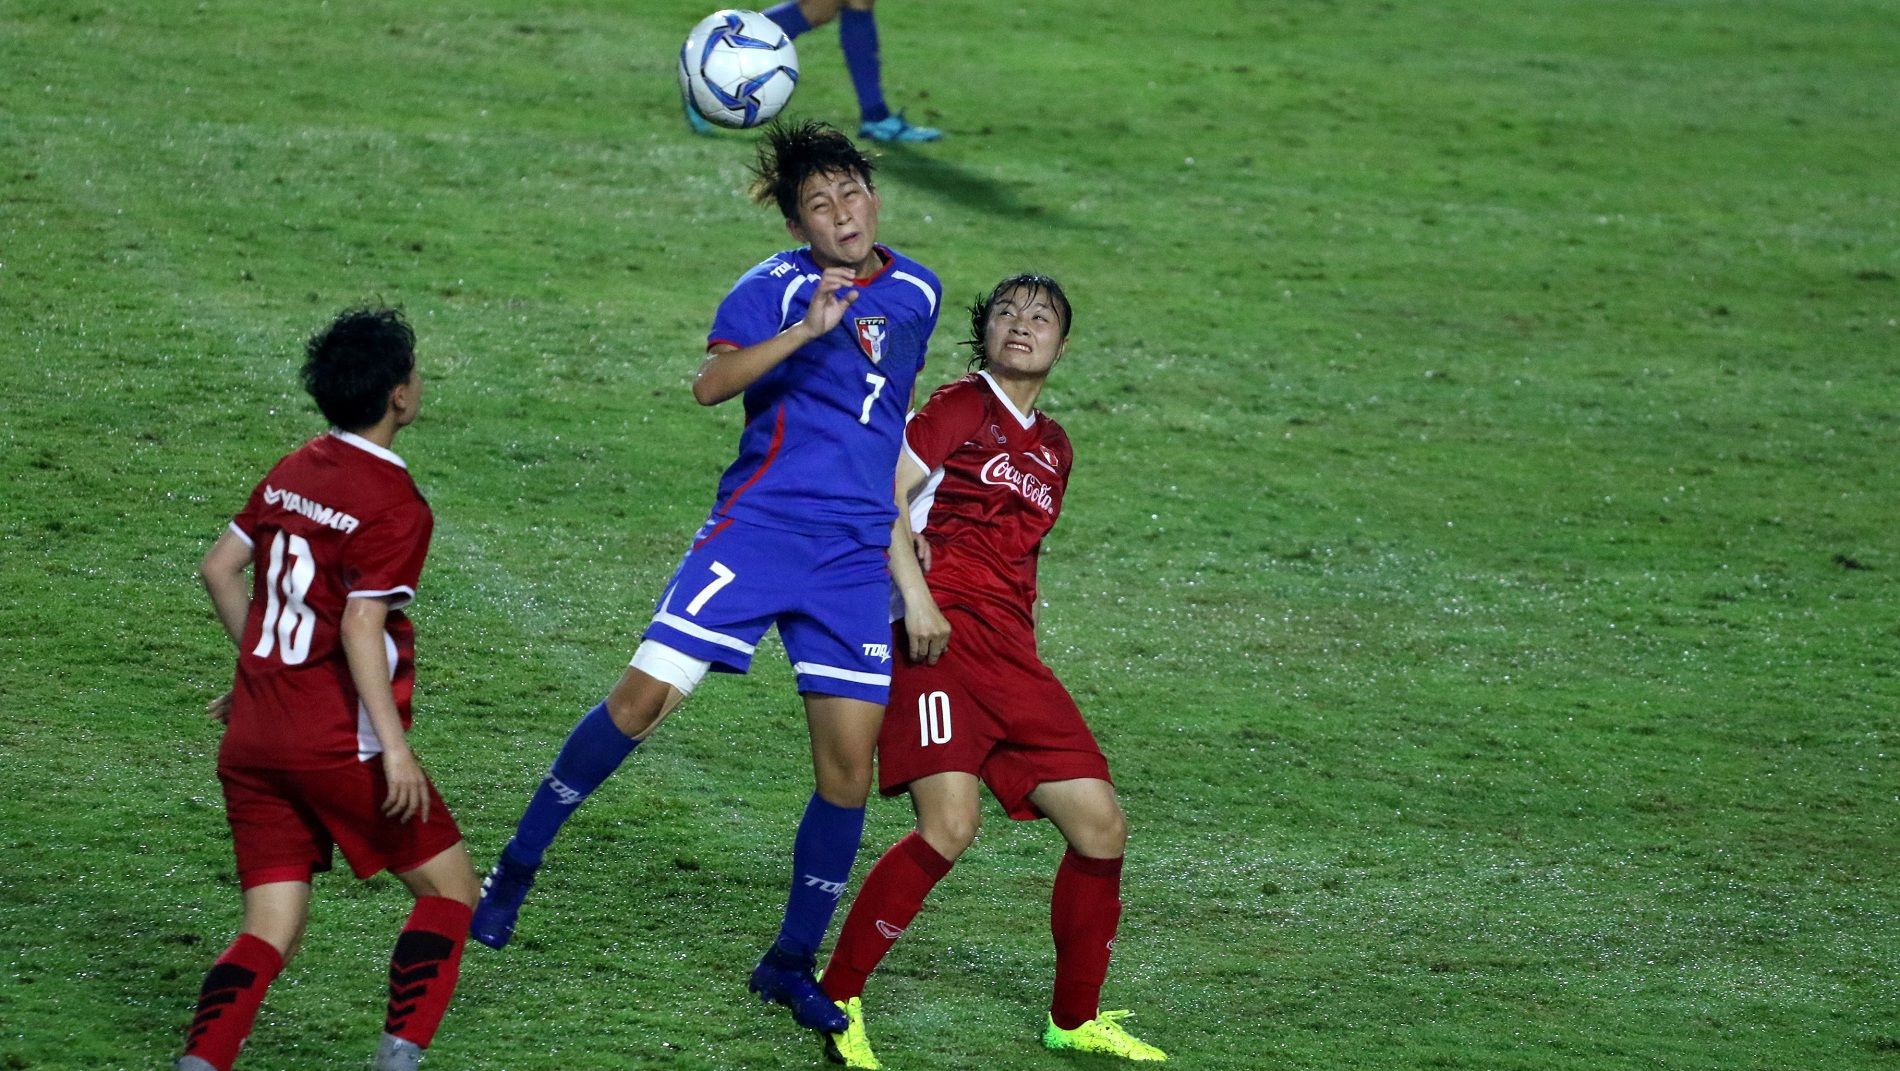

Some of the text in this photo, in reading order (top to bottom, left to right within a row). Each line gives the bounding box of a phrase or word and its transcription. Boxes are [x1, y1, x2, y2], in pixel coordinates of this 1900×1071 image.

[859, 373, 886, 425] 7
[280, 489, 360, 534] YANMAR
[252, 529, 316, 665] 18
[685, 560, 736, 616] 7
[918, 691, 952, 747] 10
